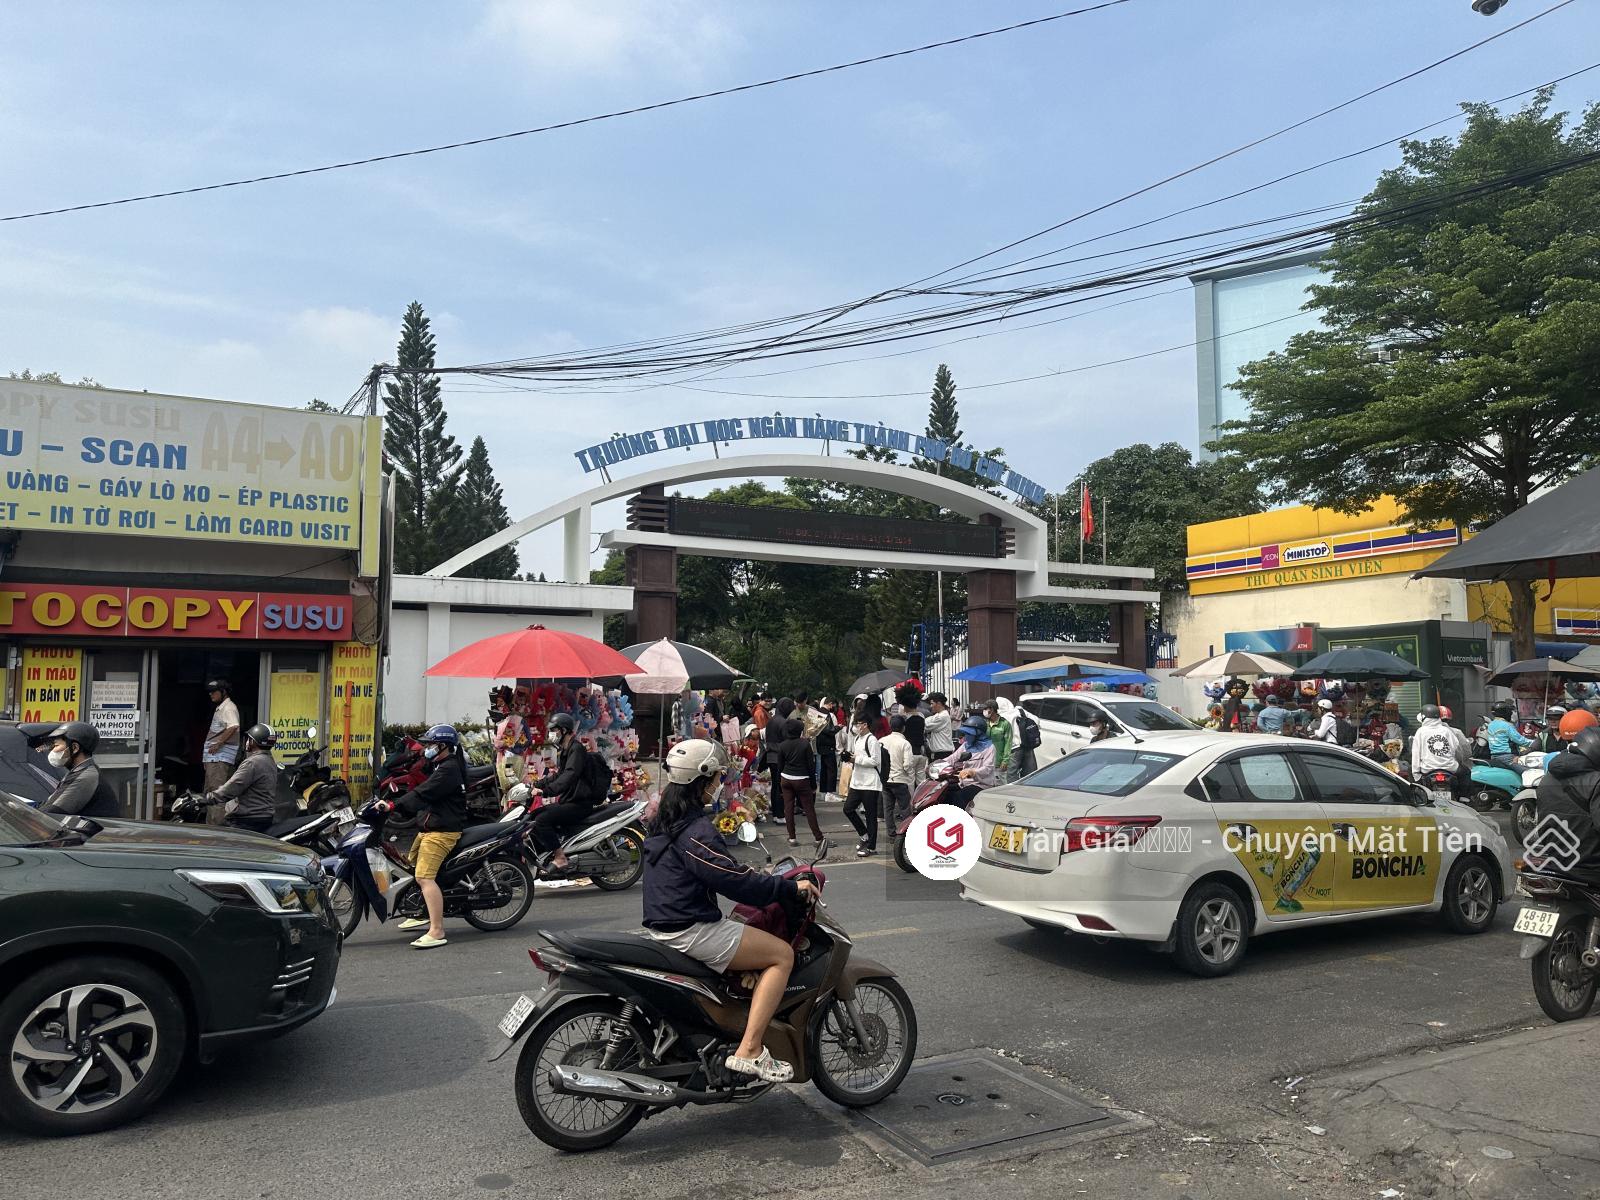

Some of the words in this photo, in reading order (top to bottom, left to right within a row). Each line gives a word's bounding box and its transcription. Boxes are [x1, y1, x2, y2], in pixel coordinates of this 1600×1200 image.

[202, 411, 262, 474] A4
[81, 437, 187, 470] SCAN
[6, 469, 69, 493] VÀNG
[100, 476, 142, 498] GÁY
[150, 480, 175, 500] LÒ
[183, 484, 210, 502] XO
[238, 486, 263, 506] ÉP
[269, 491, 349, 513] PLASTIC
[50, 505, 74, 524] IN
[83, 505, 111, 526] TỜ
[119, 509, 156, 529] RƠI
[185, 511, 231, 533] LÀM
[239, 517, 293, 537] CARD
[300, 522, 351, 541] VISIT
[1286, 546, 1327, 560] MINISTOP
[263, 604, 345, 631] SUSU
[32, 647, 74, 658] PHOTO
[339, 646, 372, 658] PHOTO
[1447, 654, 1484, 663] Vietcombank
[27, 667, 41, 681] IN
[46, 665, 77, 681] MÀU
[25, 688, 37, 702] IN
[40, 684, 61, 702] BẢN
[334, 685, 343, 698] IN
[346, 682, 361, 698] ẢN
[108, 721, 134, 729] PHOTO
[1352, 855, 1426, 880] BONCHA
[1523, 910, 1553, 923] 48-B1
[1516, 919, 1553, 935] 493.47
